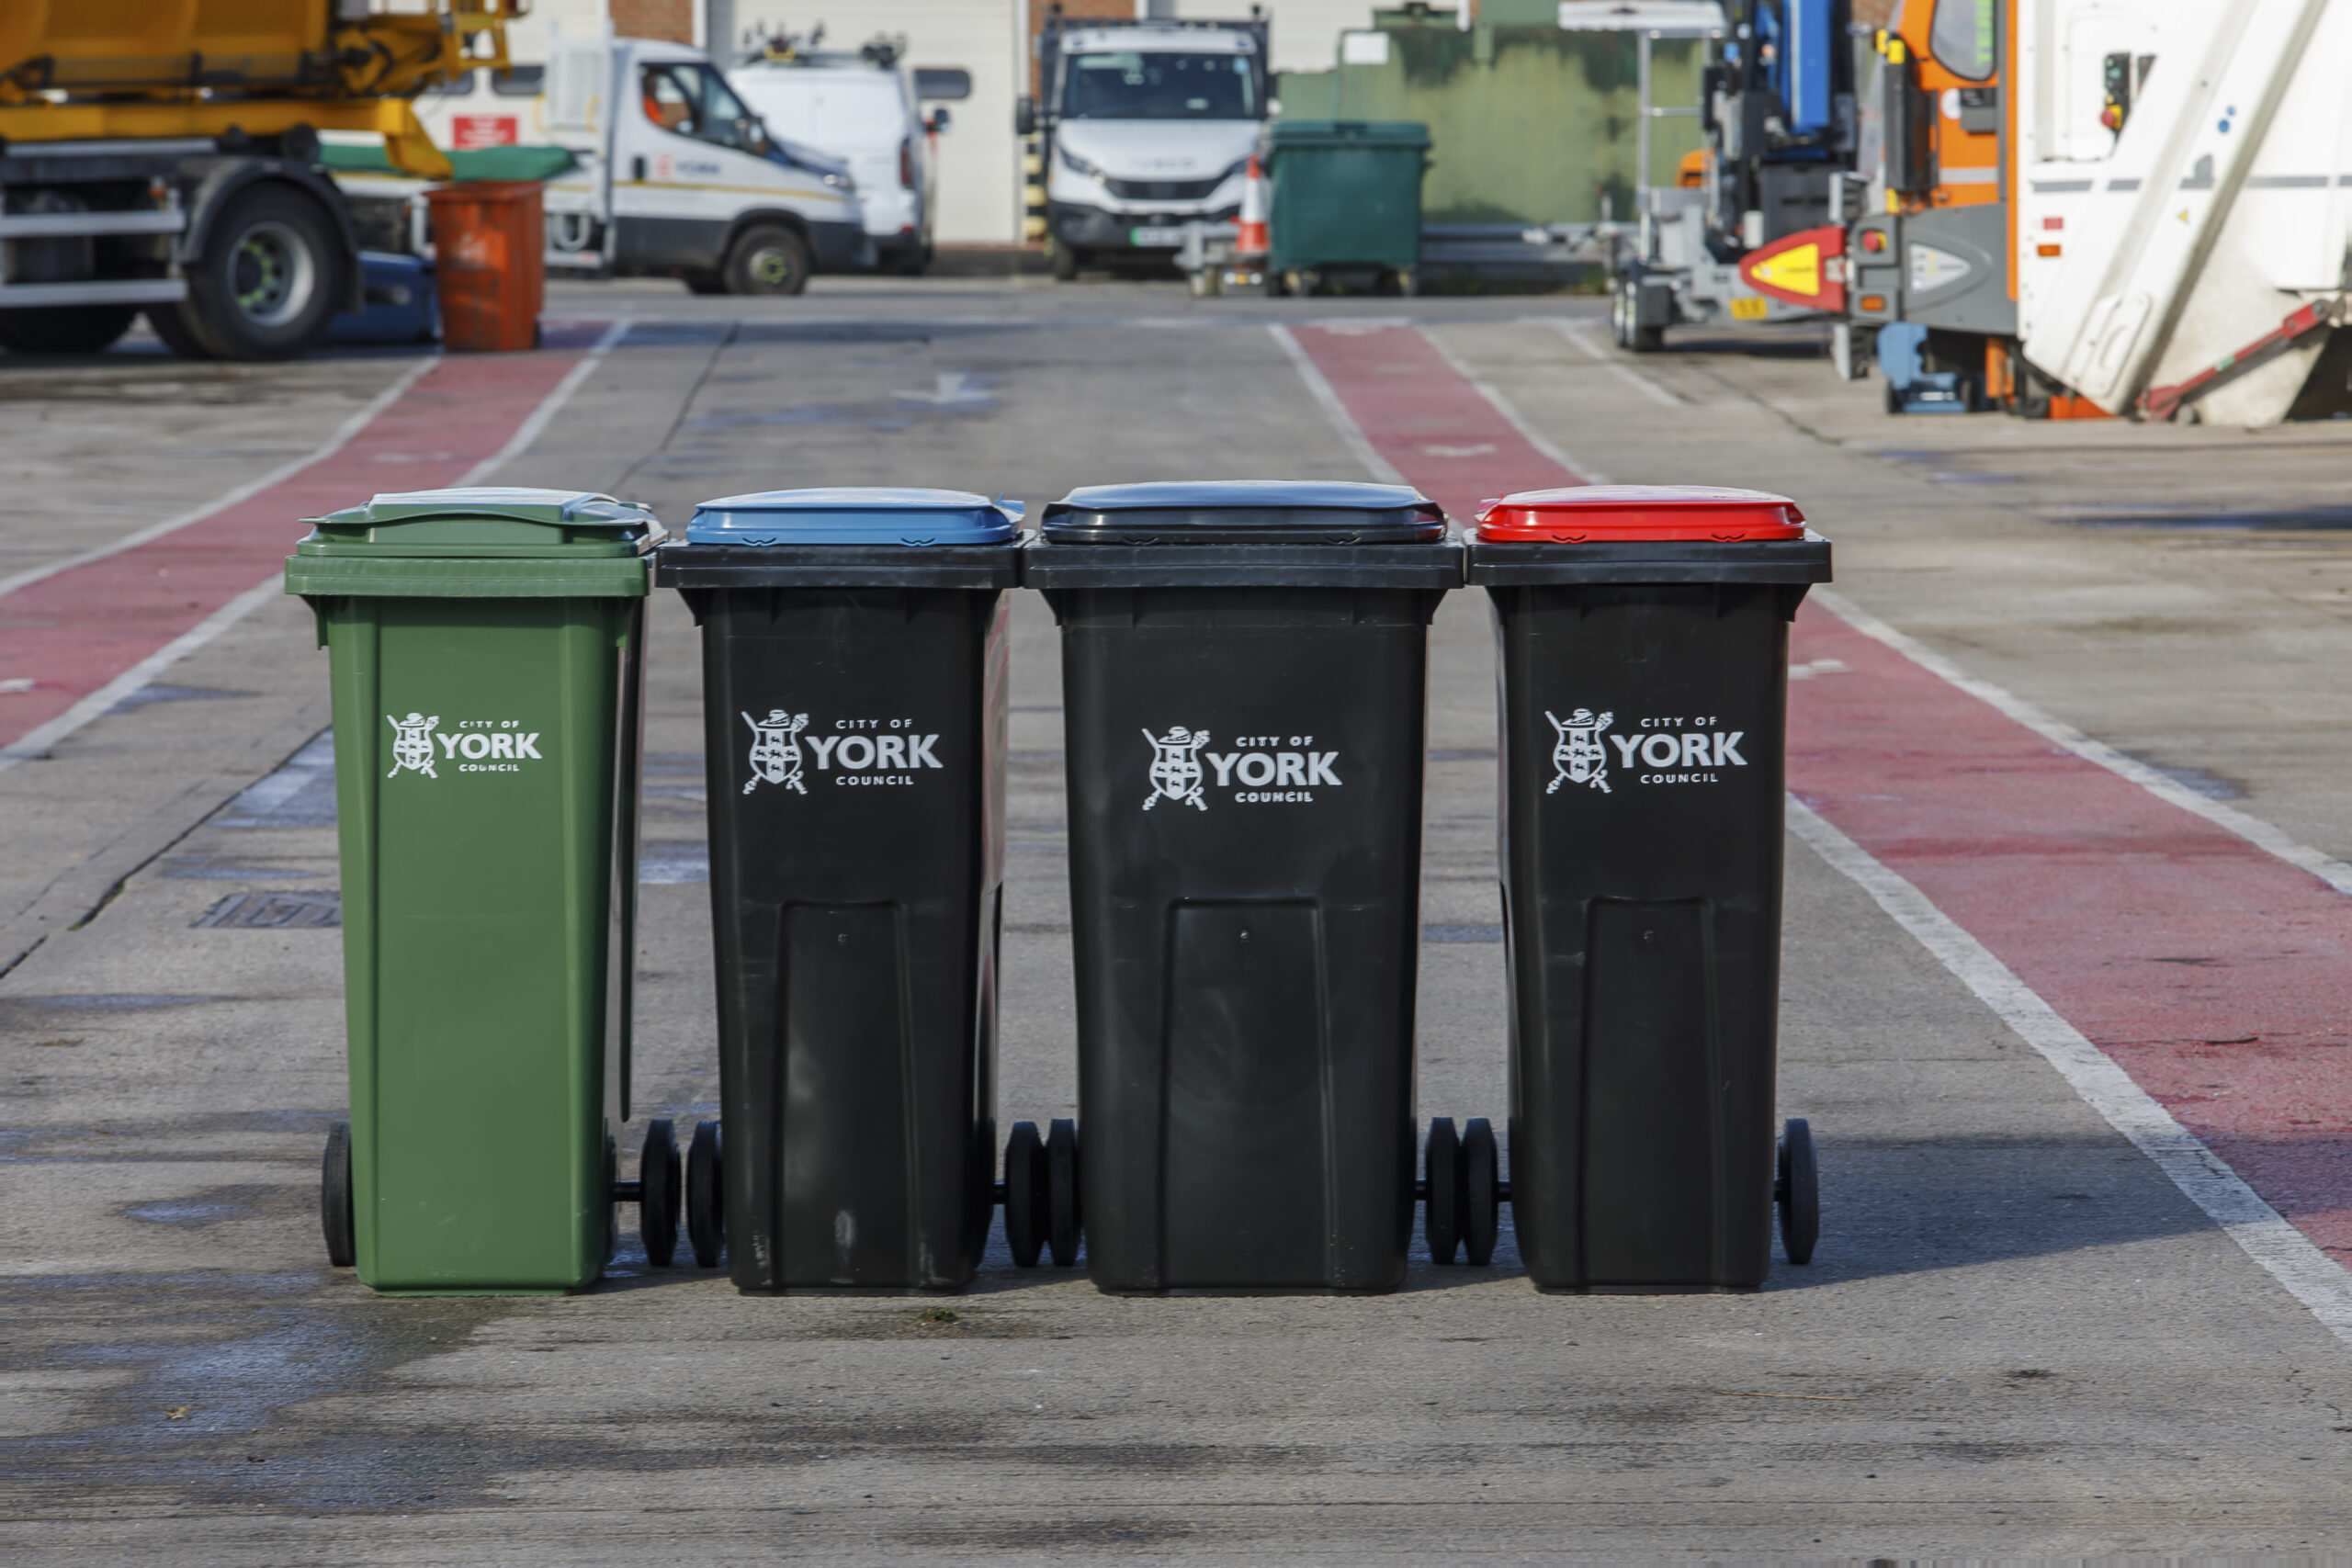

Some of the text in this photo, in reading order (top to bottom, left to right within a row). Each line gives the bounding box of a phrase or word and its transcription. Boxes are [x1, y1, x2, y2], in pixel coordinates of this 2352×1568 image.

[459, 720, 520, 728] CITY OF
[836, 719, 913, 729] CITY OF
[1641, 716, 1718, 728] CITY OF
[435, 732, 544, 760] YORK
[1236, 736, 1313, 748] CITY OF
[805, 734, 944, 770] YORK
[1610, 732, 1748, 769] YORK
[459, 764, 520, 773] COUNCIL
[1205, 751, 1343, 787] YORK
[836, 776, 914, 786] COUNCIL
[1641, 773, 1719, 784] COUNCIL
[1235, 792, 1314, 803] COUNCIL
